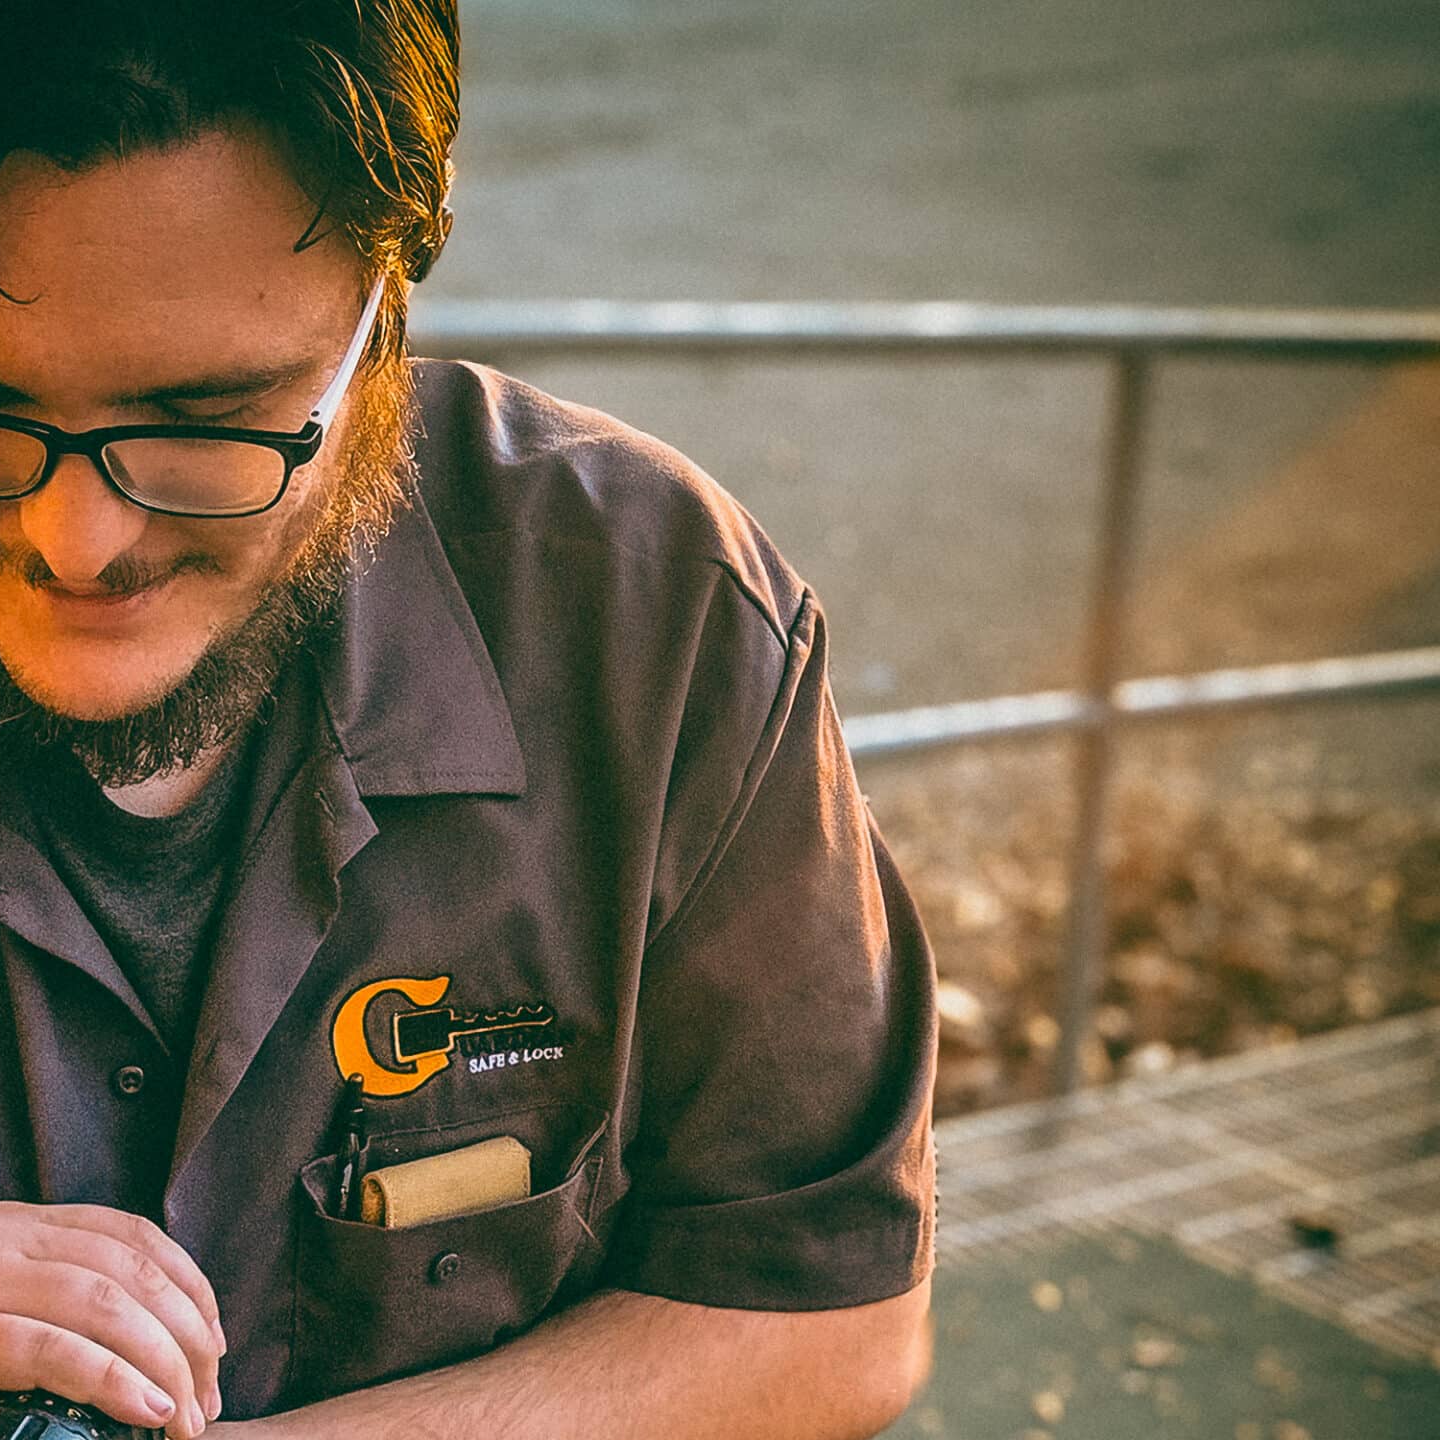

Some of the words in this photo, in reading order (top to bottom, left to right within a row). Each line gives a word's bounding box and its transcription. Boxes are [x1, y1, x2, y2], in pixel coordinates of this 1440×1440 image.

[469, 1053, 505, 1073] SAFE
[508, 1051, 519, 1065] &
[523, 1047, 564, 1062] LOCK
